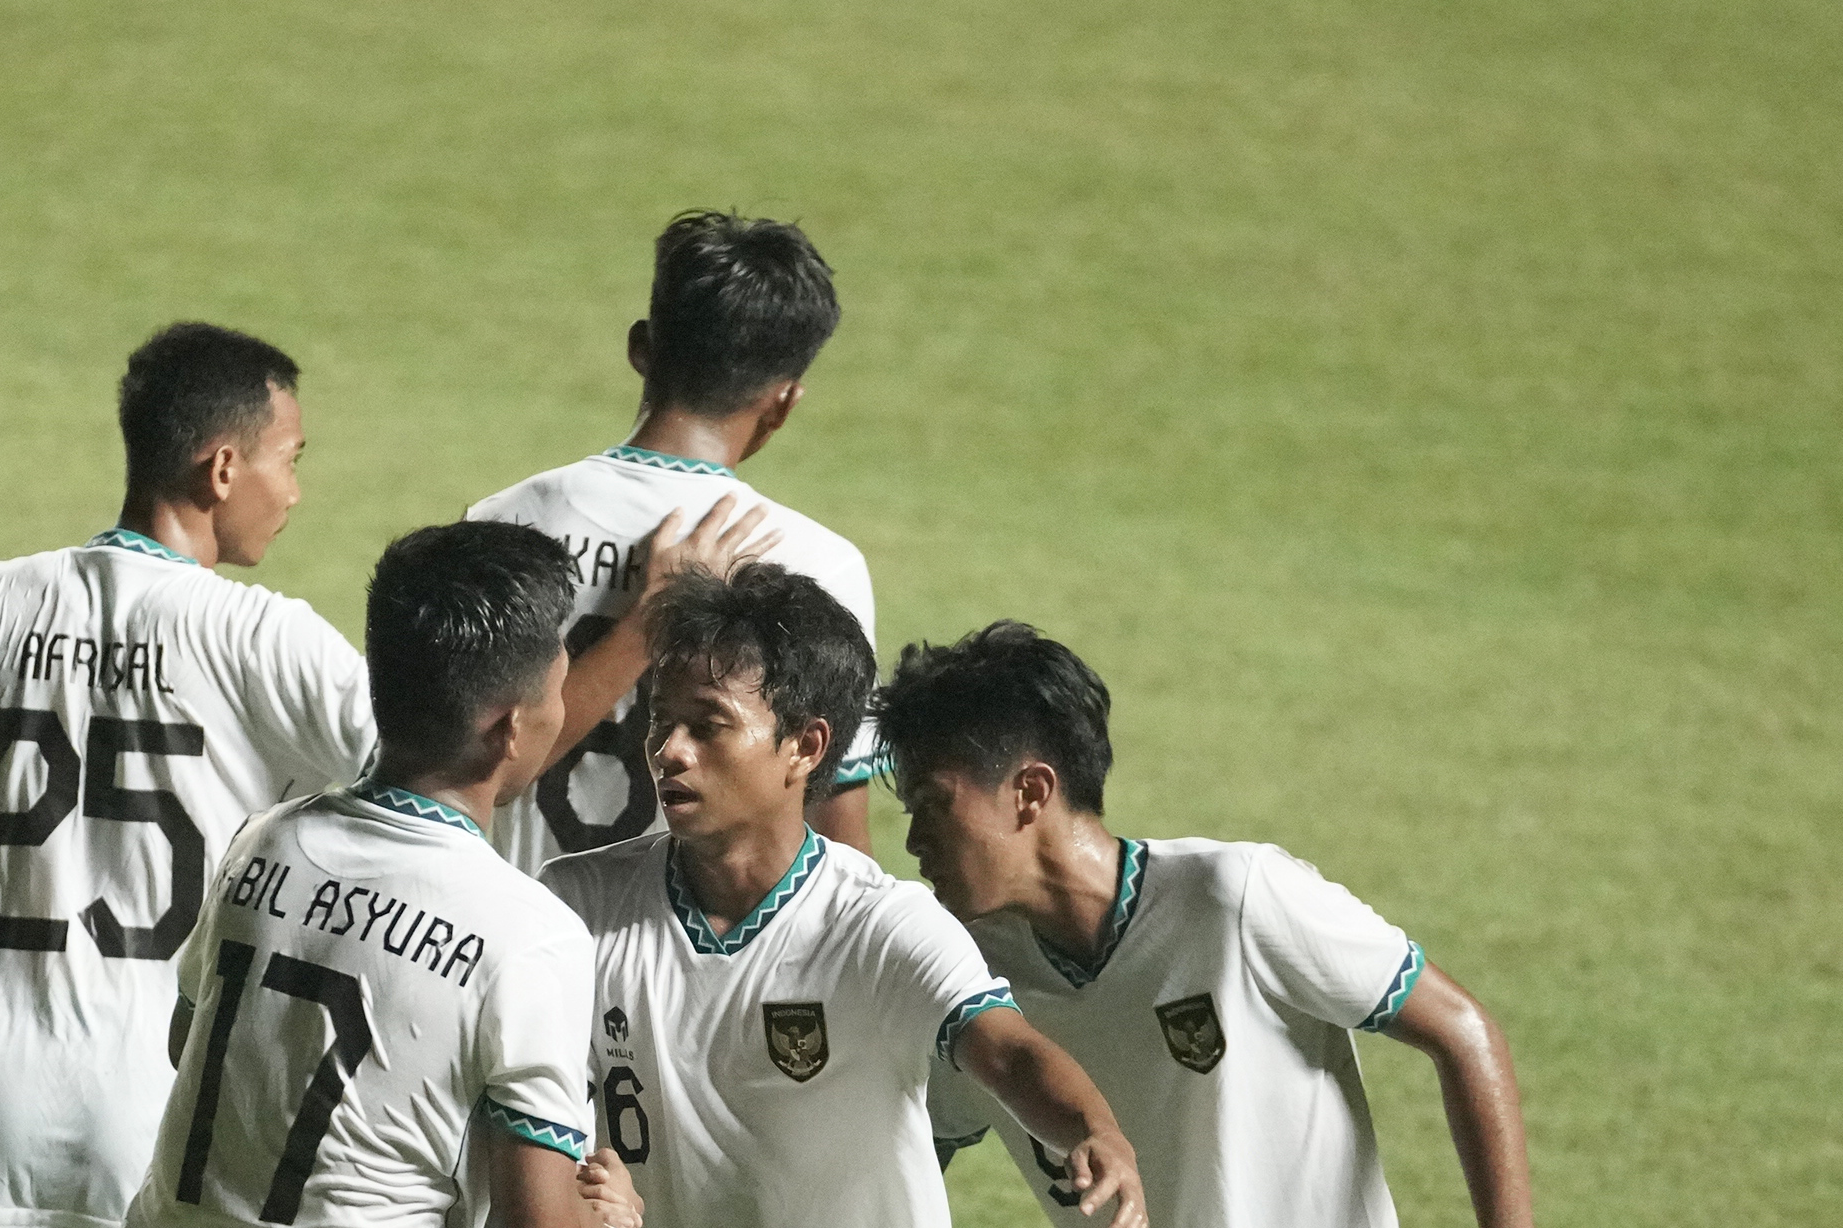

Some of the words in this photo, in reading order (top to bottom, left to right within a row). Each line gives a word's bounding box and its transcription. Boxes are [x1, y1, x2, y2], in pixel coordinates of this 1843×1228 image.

[18, 631, 174, 694] AFRISAL
[222, 856, 291, 919] BIL
[302, 879, 485, 988] ASYURA
[771, 1008, 816, 1018] INDONESIA
[176, 938, 372, 1226] 17
[606, 1048, 634, 1061] MILLS
[603, 1066, 650, 1165] 6
